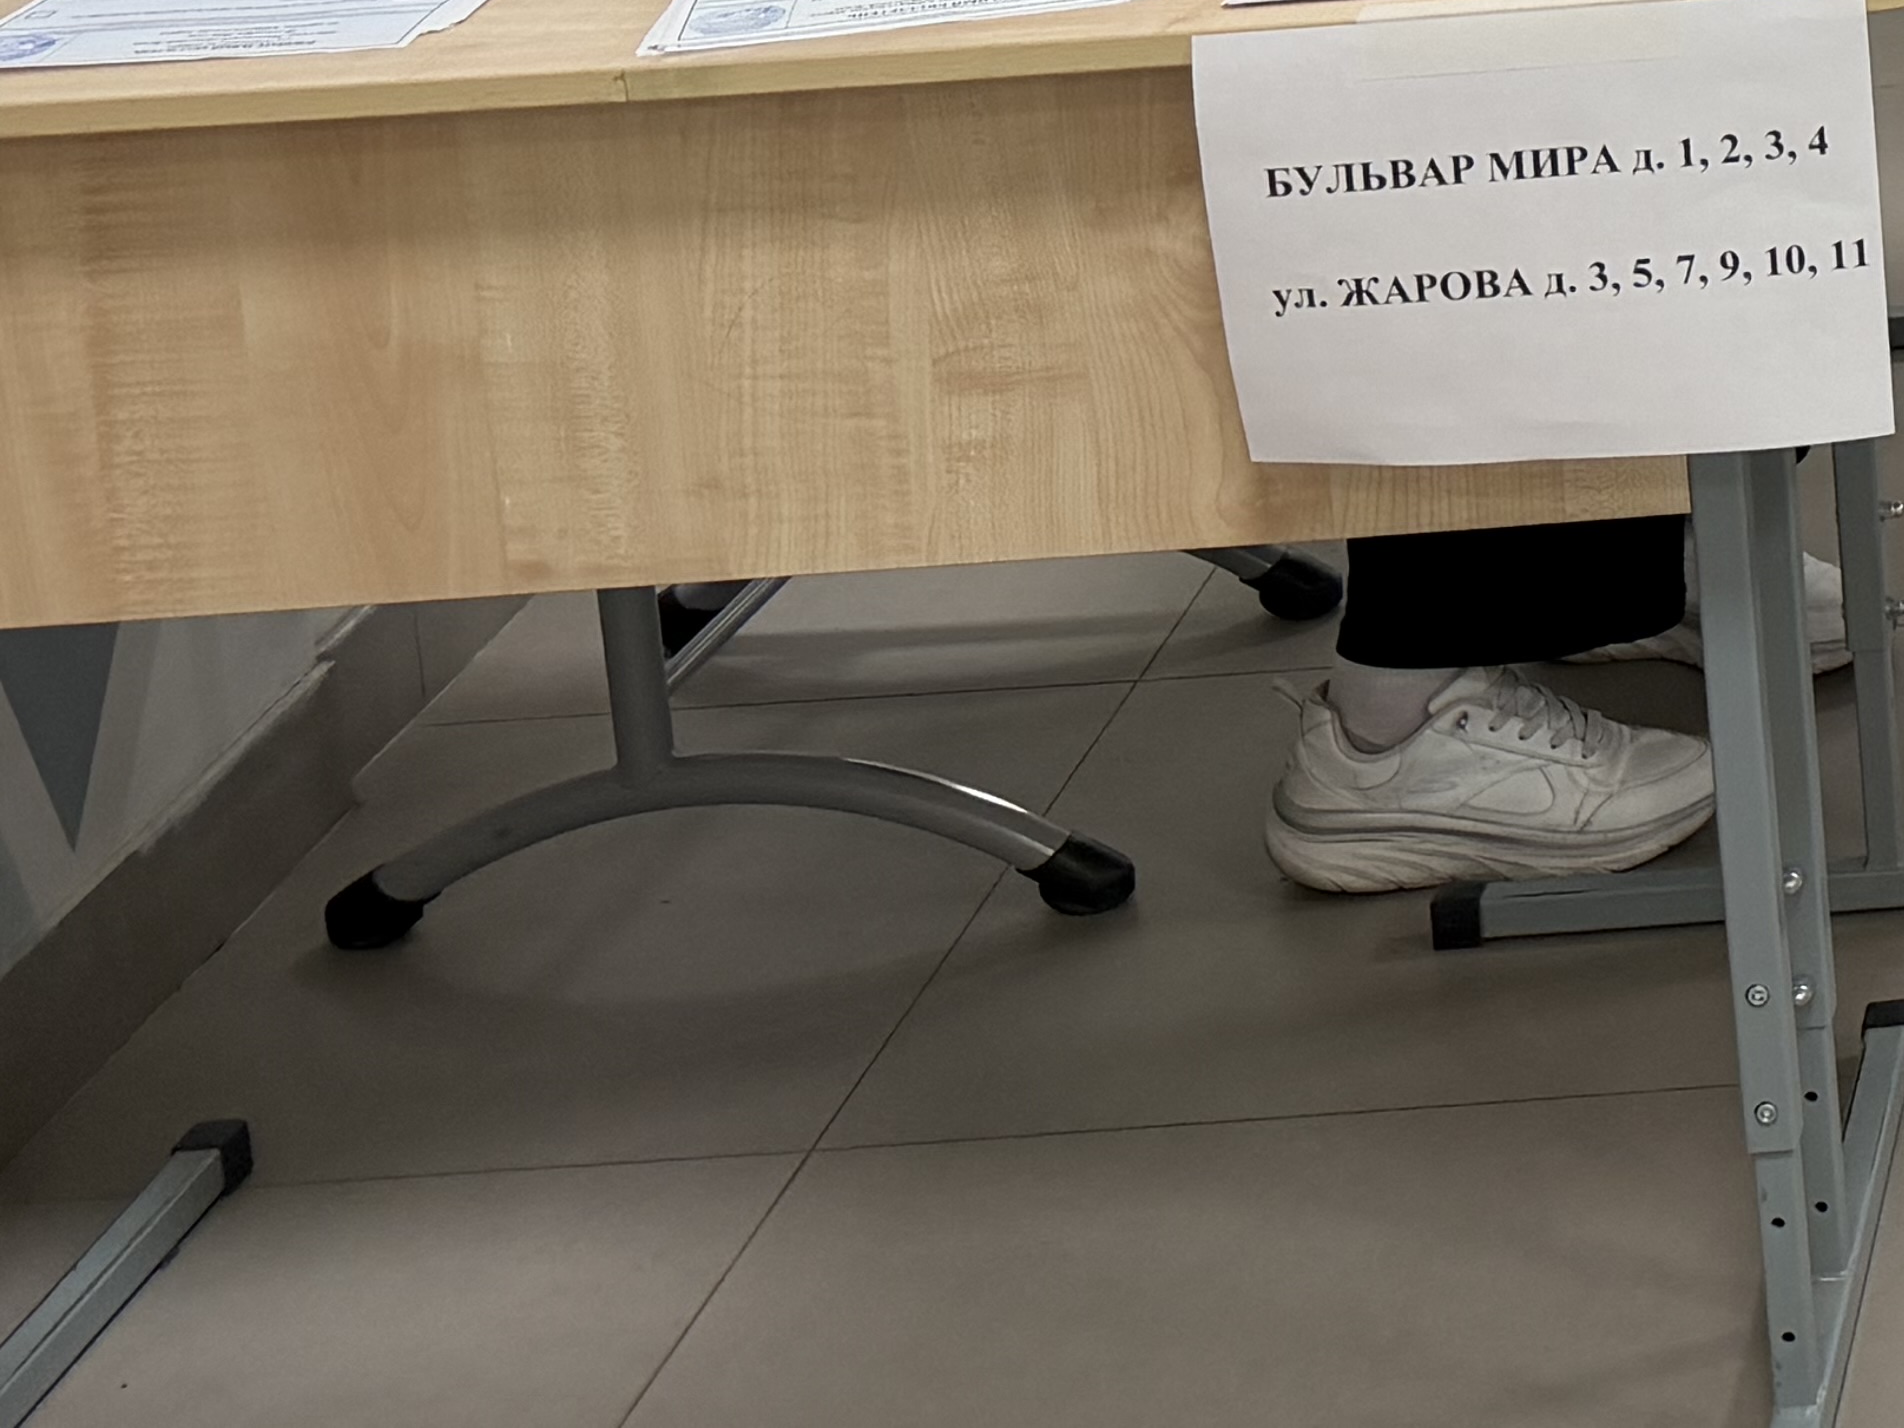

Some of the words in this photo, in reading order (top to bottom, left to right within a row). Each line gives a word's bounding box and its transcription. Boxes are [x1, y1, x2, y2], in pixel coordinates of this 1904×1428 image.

[1265, 153, 1475, 200] БУЛЬВАР
[1488, 143, 1621, 184] МИРА
[1632, 148, 1665, 176] д.
[1681, 138, 1710, 173] 1,
[1720, 132, 1754, 169] 2,
[1765, 128, 1798, 163] 3,
[1808, 125, 1830, 156] 4
[1272, 287, 1329, 319] ул.
[1337, 266, 1533, 308] ЖАРОВА
[1544, 272, 1577, 299] д.
[1589, 260, 1622, 296] 3,
[1633, 257, 1666, 293] 5,
[1676, 253, 1709, 287] 7,
[1719, 249, 1753, 285] 9,
[1766, 243, 1819, 277] 10,
[1832, 237, 1868, 271] 11
